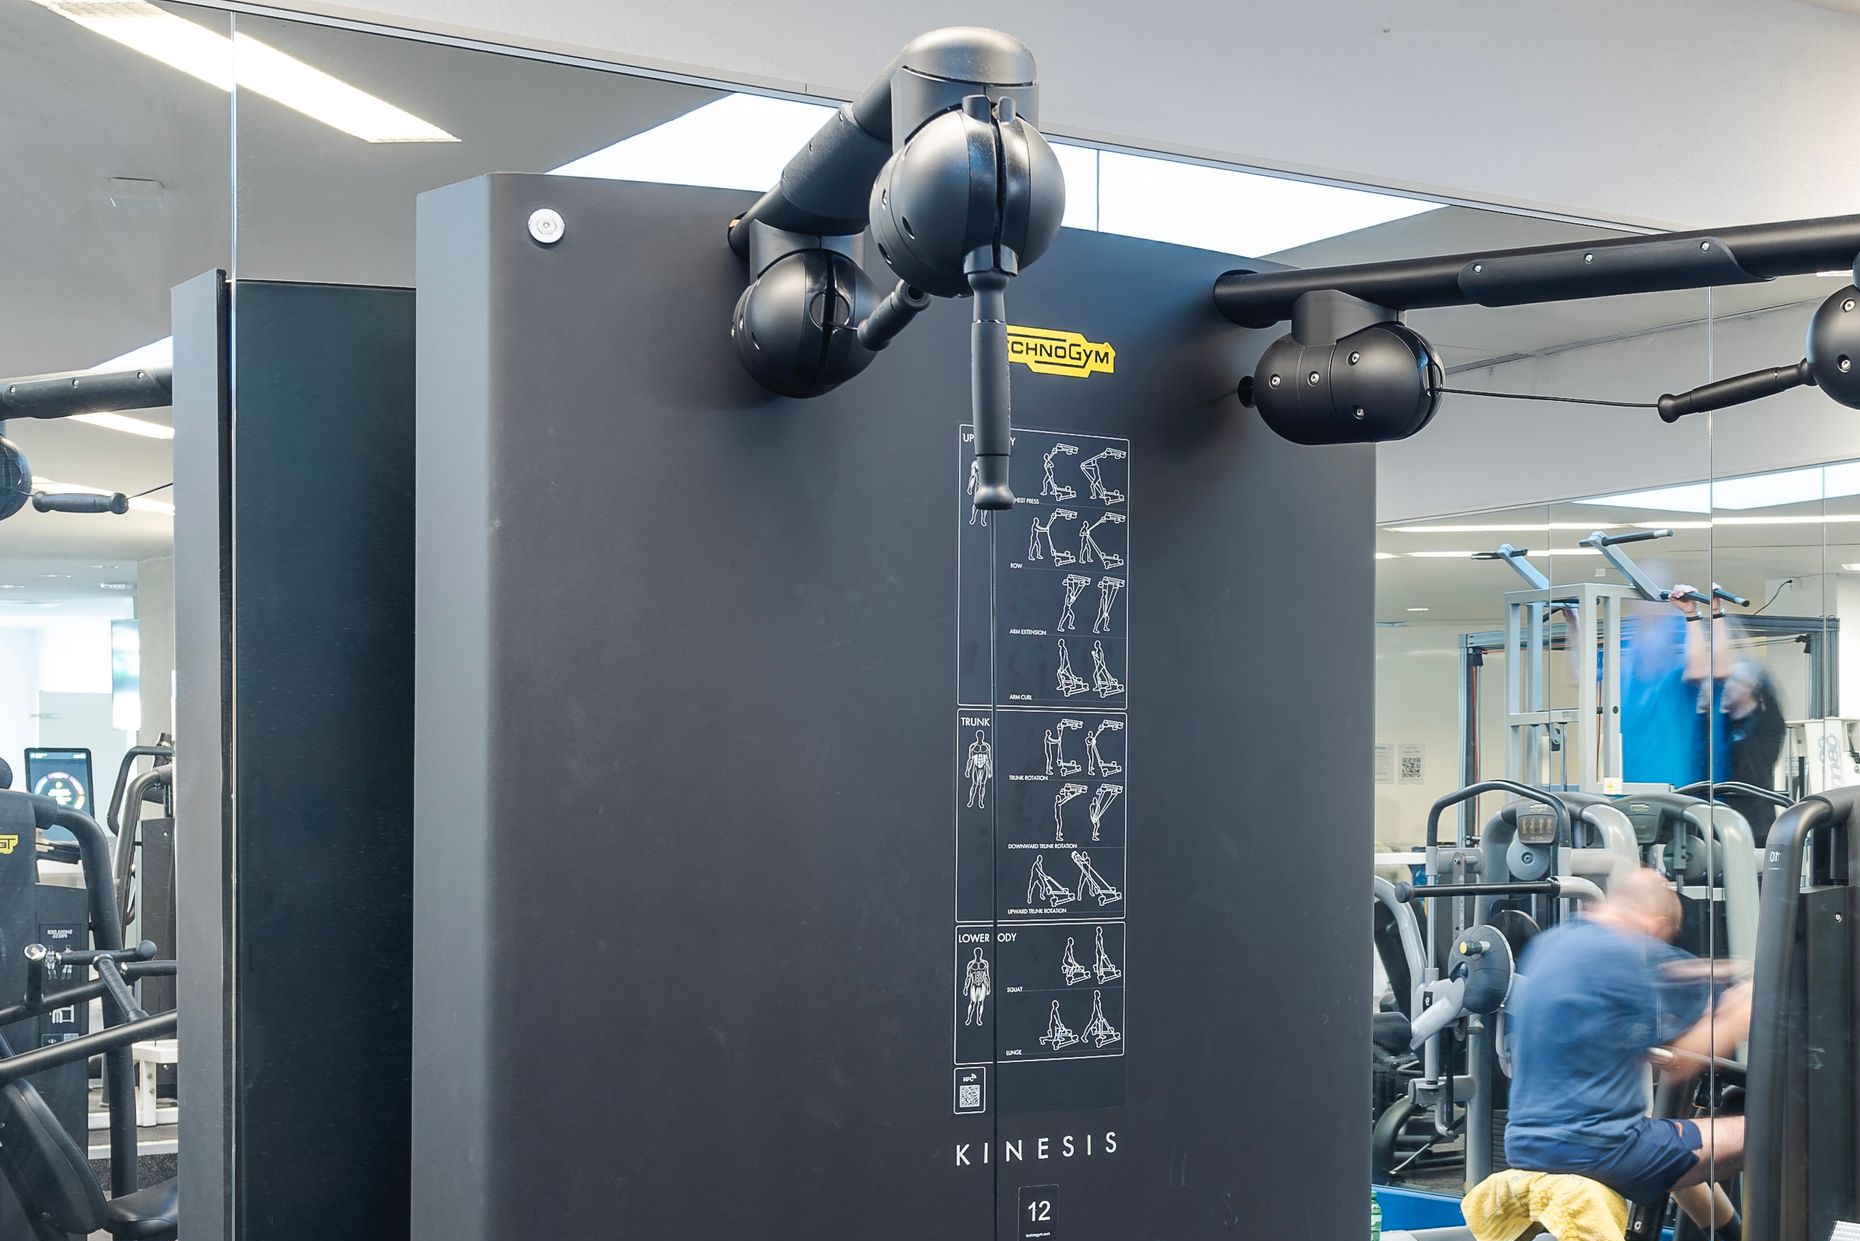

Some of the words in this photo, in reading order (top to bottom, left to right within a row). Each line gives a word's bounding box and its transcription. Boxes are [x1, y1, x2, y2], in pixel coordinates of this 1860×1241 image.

[1007, 341, 1109, 368] CHNOGYM
[960, 717, 991, 727] TRUNK
[958, 933, 990, 943] LOWER
[994, 932, 1017, 942] ODY
[956, 1131, 1117, 1166] KINESIS
[1028, 1200, 1051, 1222] 12
